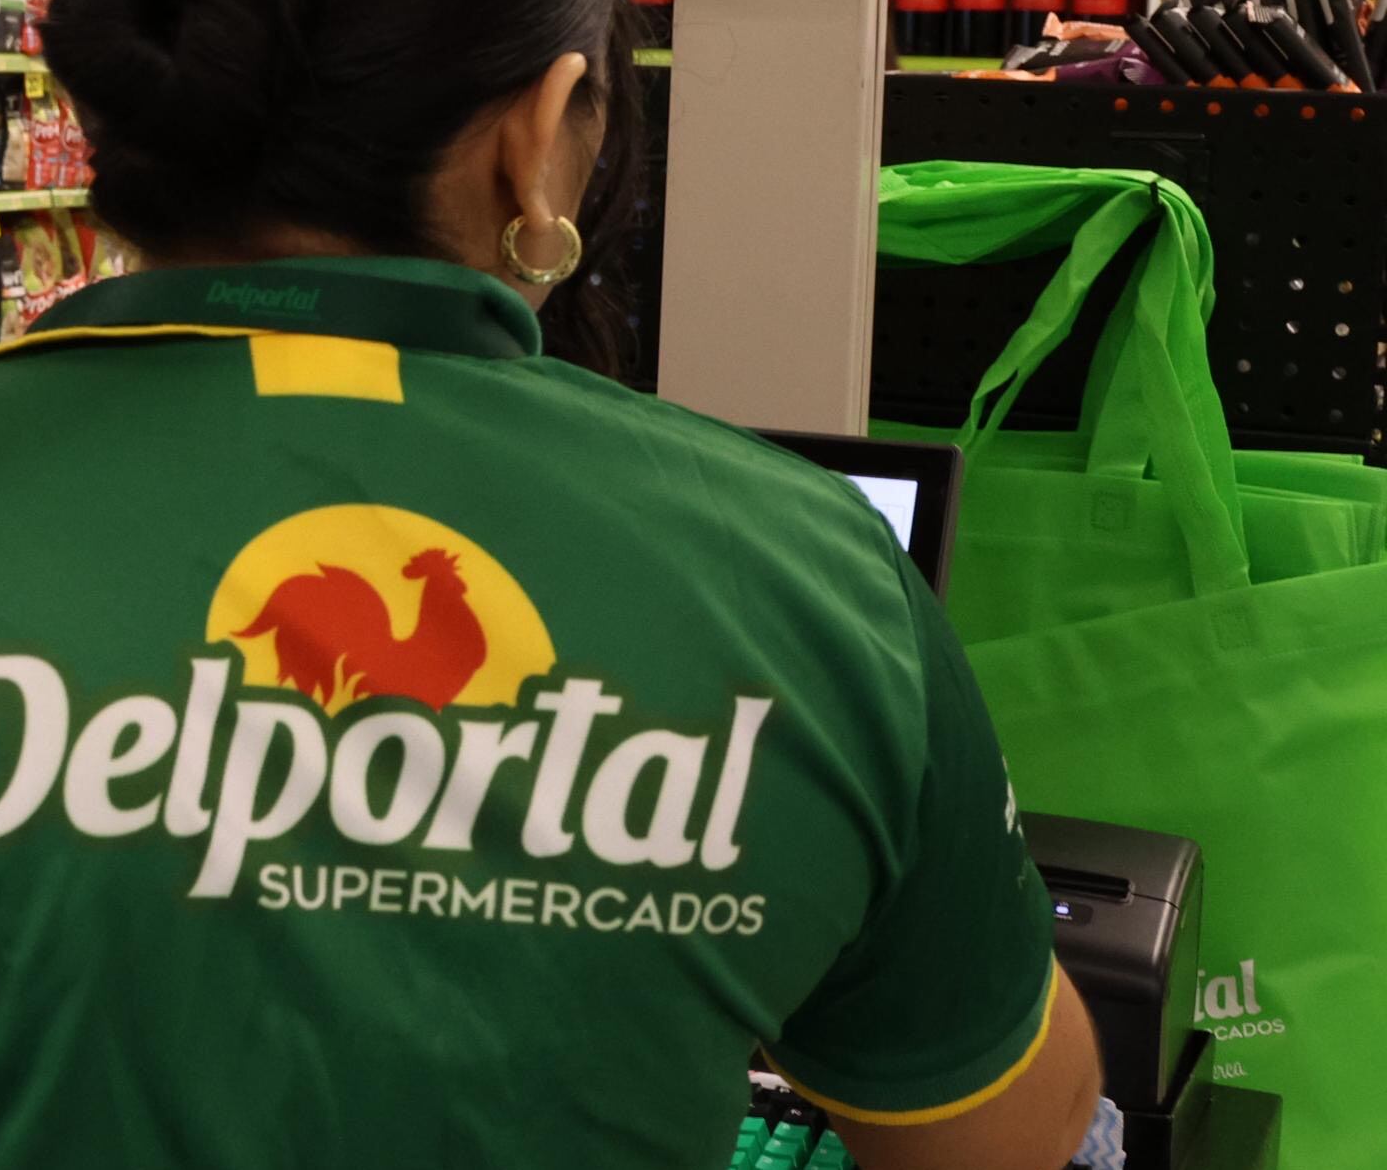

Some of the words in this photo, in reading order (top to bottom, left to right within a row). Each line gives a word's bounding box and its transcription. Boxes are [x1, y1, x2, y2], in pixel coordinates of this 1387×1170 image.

[206, 280, 321, 314] Delportal
[256, 863, 767, 937] SUPERMERCADOS
[1207, 1017, 1287, 1042] CADOS
